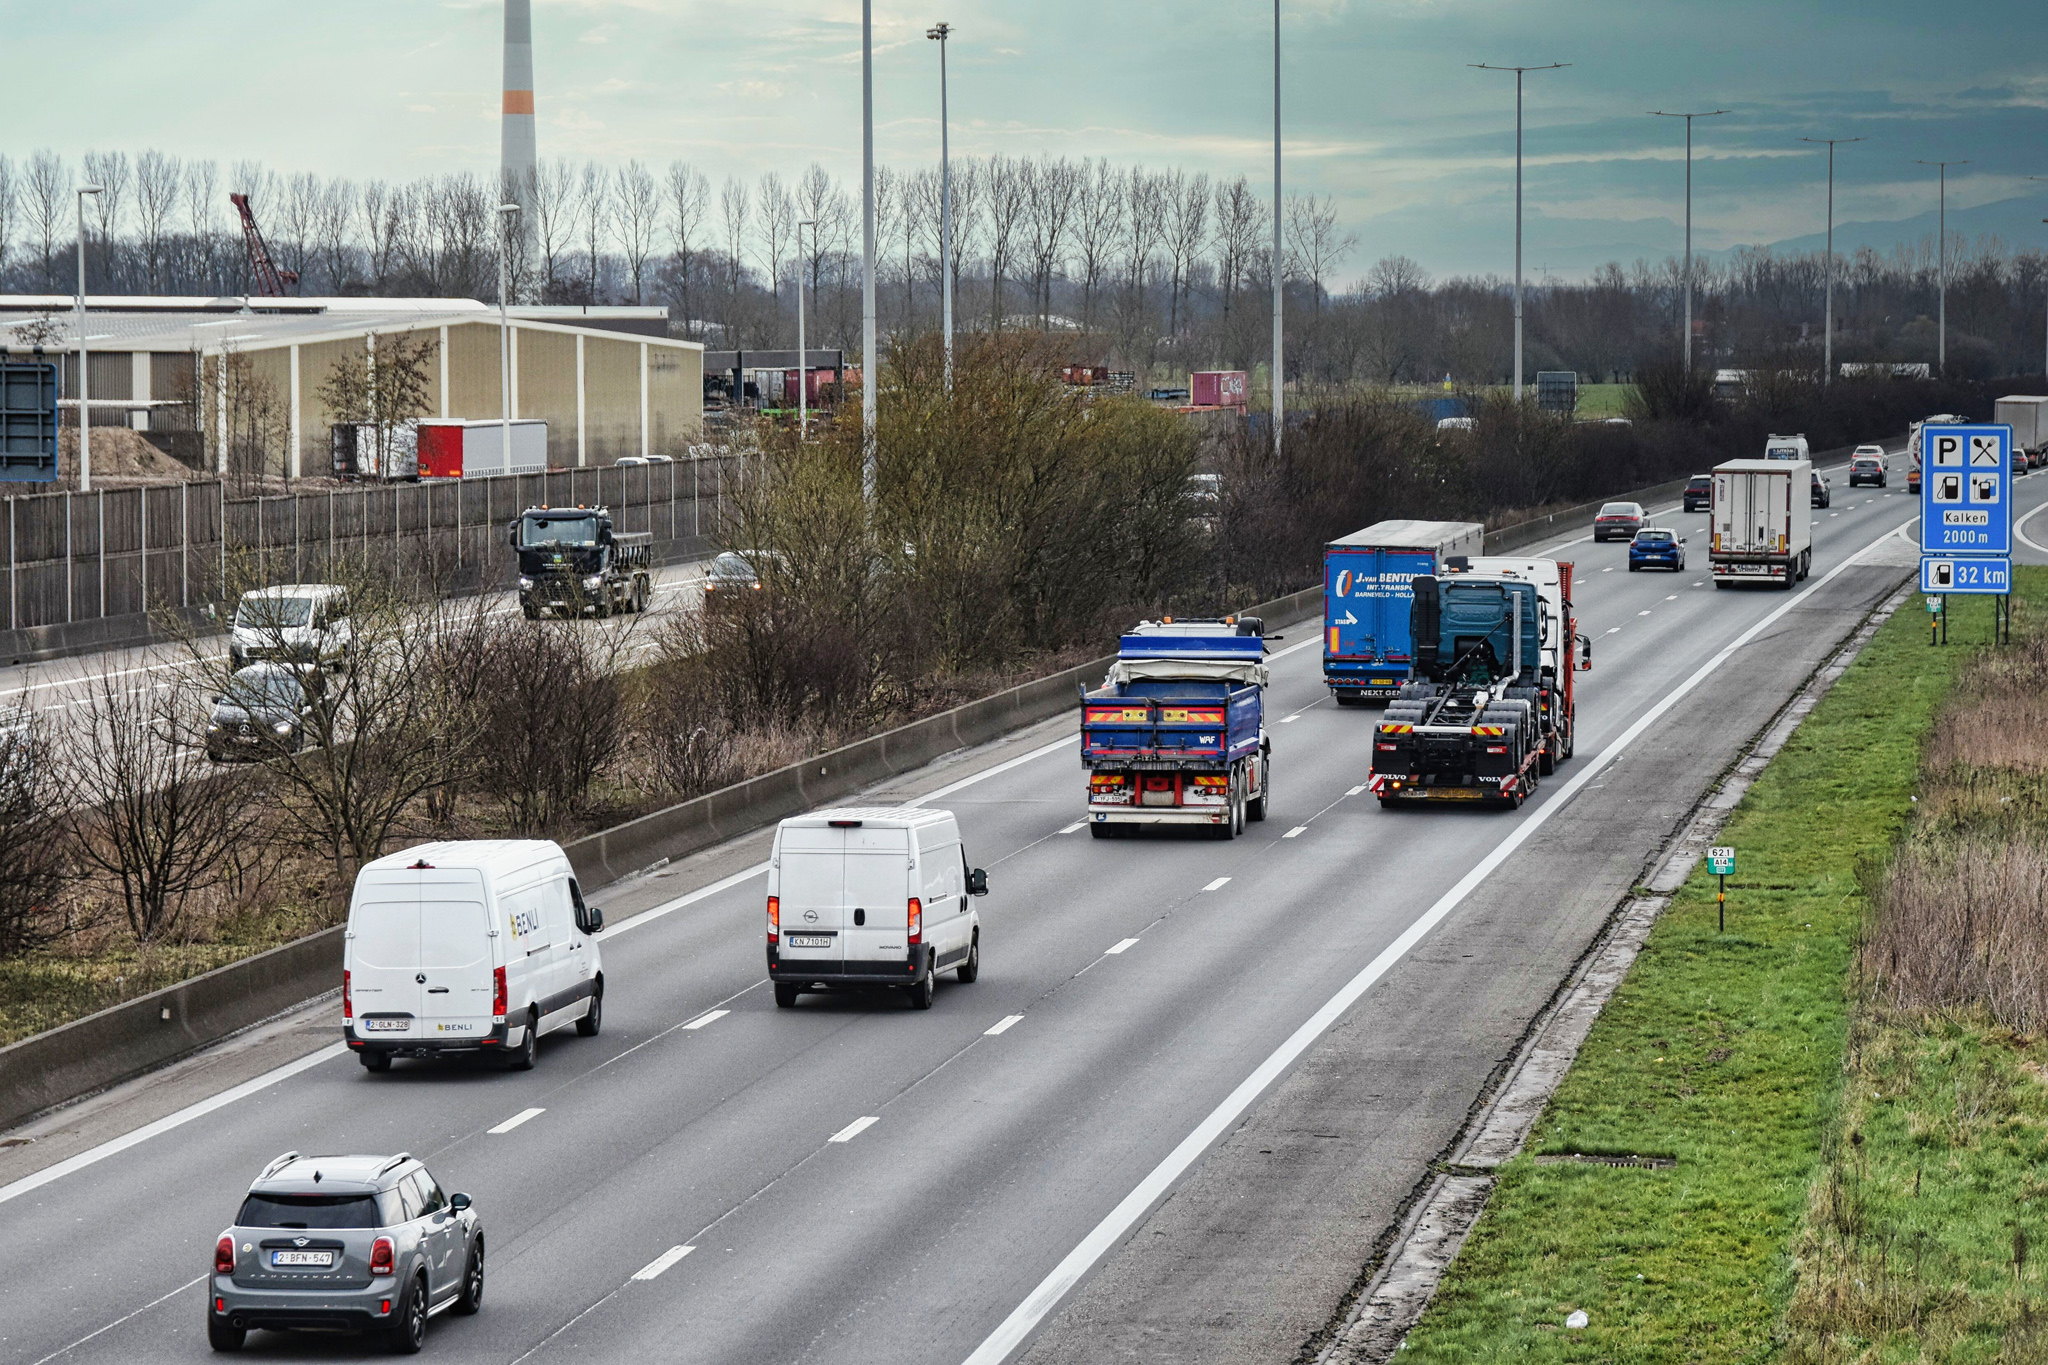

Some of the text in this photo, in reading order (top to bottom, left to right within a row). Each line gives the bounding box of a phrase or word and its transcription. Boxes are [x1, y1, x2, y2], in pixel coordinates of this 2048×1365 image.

[1938, 437, 1957, 464] P
[1945, 512, 1987, 523] Kalken
[1943, 529, 1988, 544] 2000 m
[1379, 573, 1422, 583] BENTU
[1958, 566, 2005, 584] 32 km
[1712, 848, 1730, 857] 62.1
[515, 907, 539, 937] BENLI
[794, 938, 805, 946] KN
